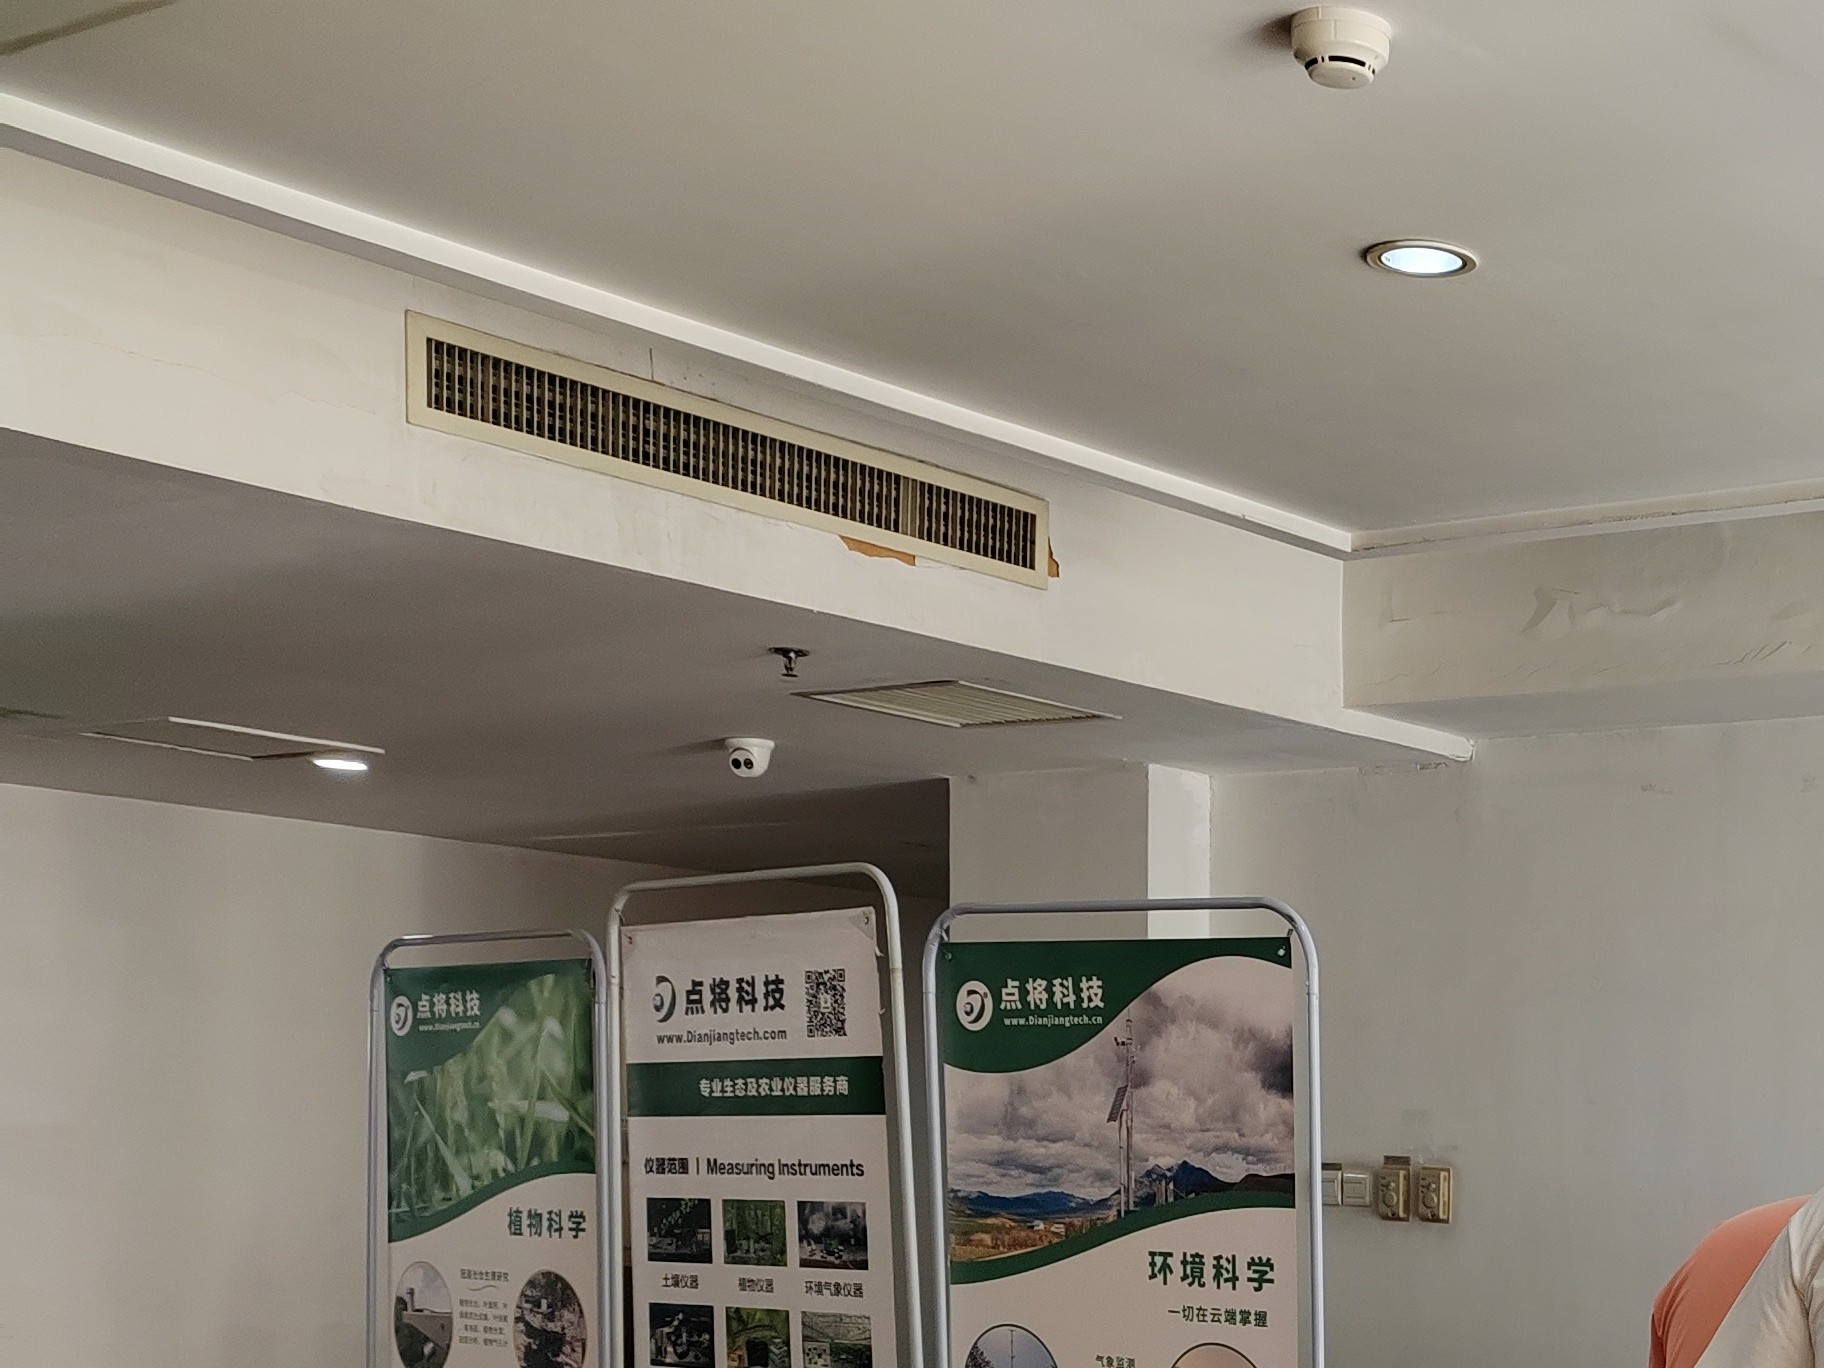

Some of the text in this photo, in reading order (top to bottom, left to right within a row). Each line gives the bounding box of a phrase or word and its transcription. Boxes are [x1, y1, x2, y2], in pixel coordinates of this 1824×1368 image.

[416, 990, 480, 1018] 点将科技
[684, 974, 786, 1016] 点将科技
[1000, 976, 1104, 1010] 点将科技
[1003, 1015, 1103, 1027] www.Dianjiangtech.cn
[656, 1028, 787, 1045] www.Dianjiangtech.com
[699, 1075, 849, 1097] 专业生态及农业仪器服务商
[644, 1157, 865, 1180] 仪器范围 Measuring Instruments
[507, 1206, 587, 1239] 植物科学
[1148, 1250, 1275, 1292] 环境科学
[1167, 1305, 1268, 1328] 一切在云端掌握
